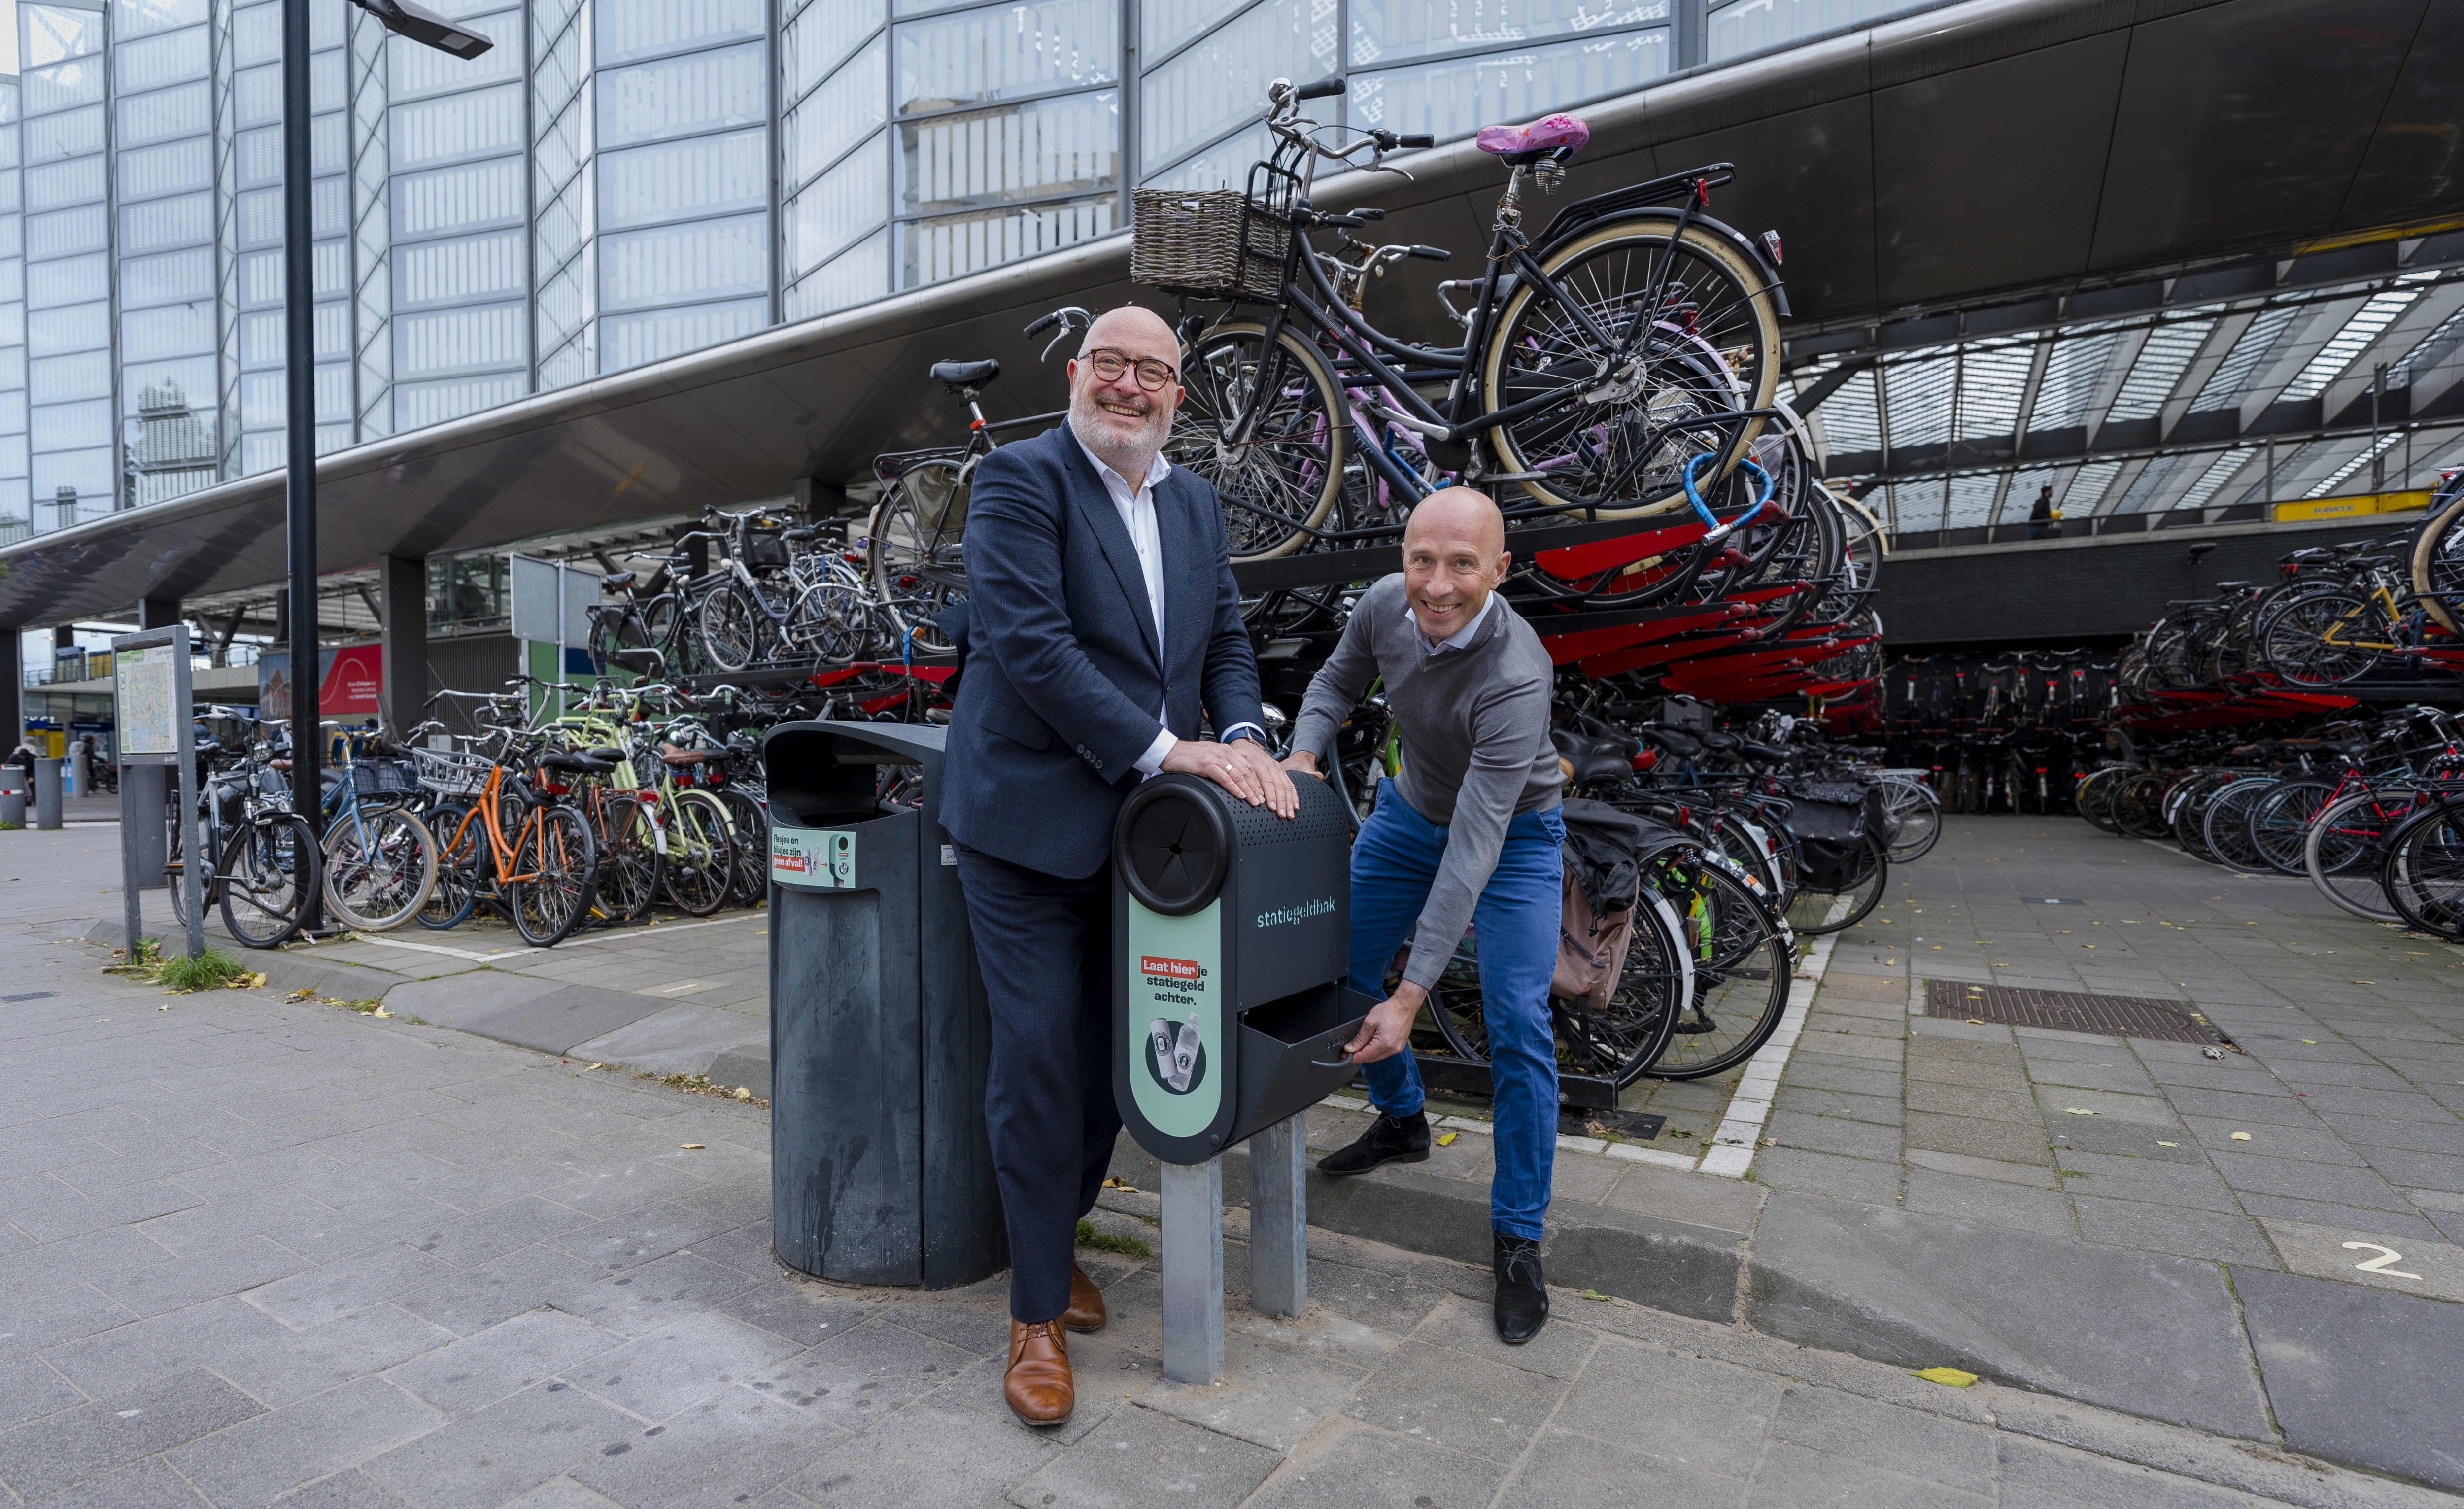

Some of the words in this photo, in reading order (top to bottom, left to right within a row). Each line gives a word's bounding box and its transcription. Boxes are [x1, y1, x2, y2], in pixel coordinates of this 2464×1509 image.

[1679, 235, 1702, 246] CHWALBE
[1312, 308, 1347, 339] BATAVUS
[774, 834, 789, 845] Flesjes
[774, 845, 788, 856] blikjes
[790, 848, 801, 857] zijn
[774, 857, 784, 866] geen
[785, 858, 803, 867] afval!
[1258, 895, 1336, 927] statiegeldbak
[1143, 960, 1168, 972] Laat
[1171, 962, 1195, 975] hier
[1197, 965, 1208, 978] je
[1147, 976, 1204, 992] statiegeld
[1154, 992, 1197, 1005] achter.
[2342, 1241, 2423, 1280] 2
